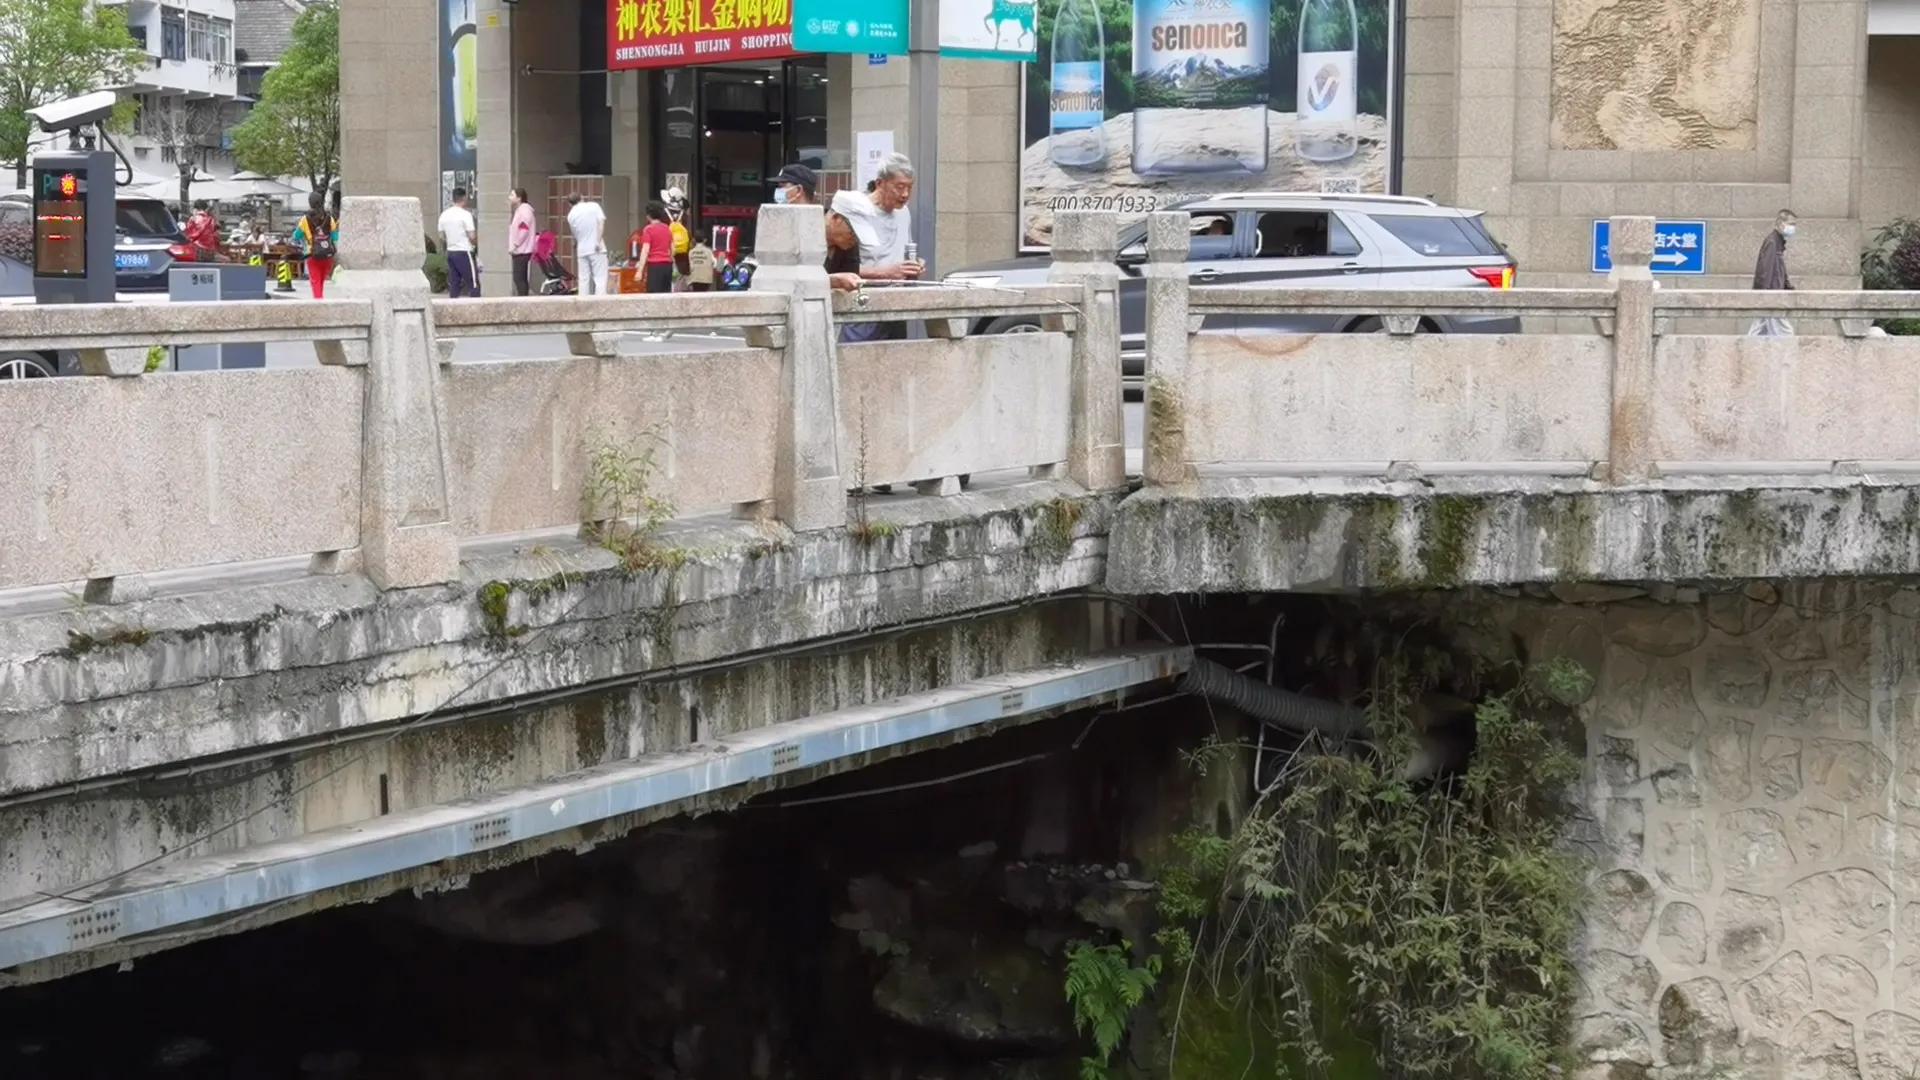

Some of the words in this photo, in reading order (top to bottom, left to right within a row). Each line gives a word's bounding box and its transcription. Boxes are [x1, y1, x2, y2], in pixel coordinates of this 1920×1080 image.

[616, 0, 793, 41] 神农架汇金购物
[616, 43, 684, 60] SHENNONGJIA
[695, 38, 731, 54] HUIJIN
[1151, 21, 1248, 52] senonca
[1118, 195, 1157, 213] 1933
